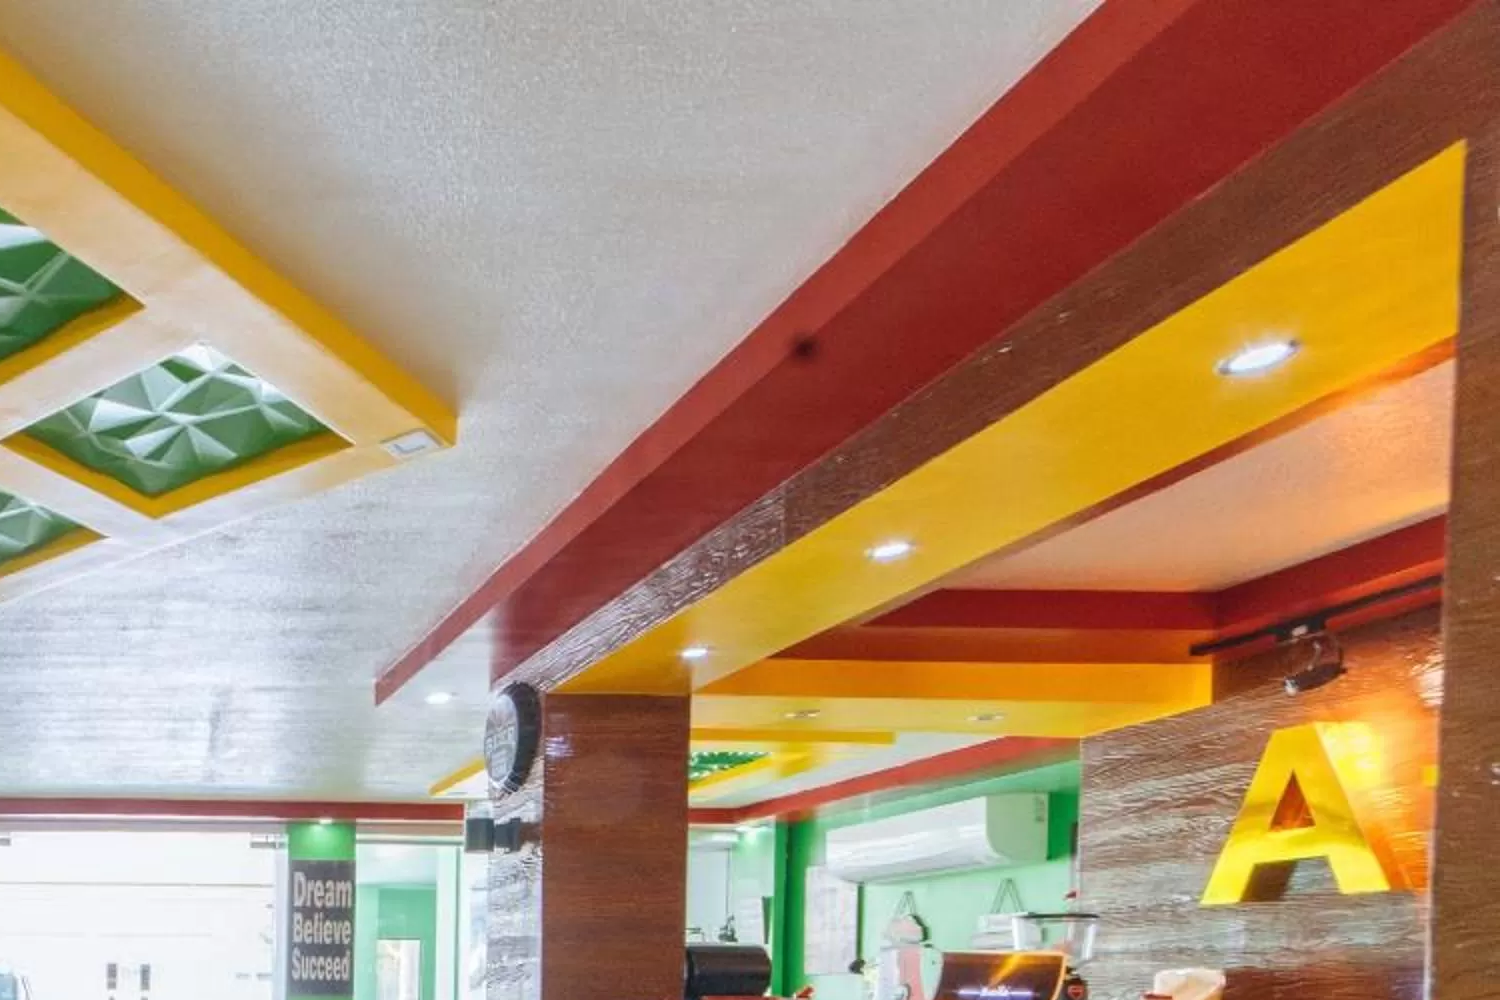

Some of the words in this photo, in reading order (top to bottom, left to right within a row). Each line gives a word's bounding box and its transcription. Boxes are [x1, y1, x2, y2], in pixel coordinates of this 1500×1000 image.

[292, 871, 352, 909] Dream
[292, 911, 352, 945] Believe
[291, 947, 350, 981] Succeed
